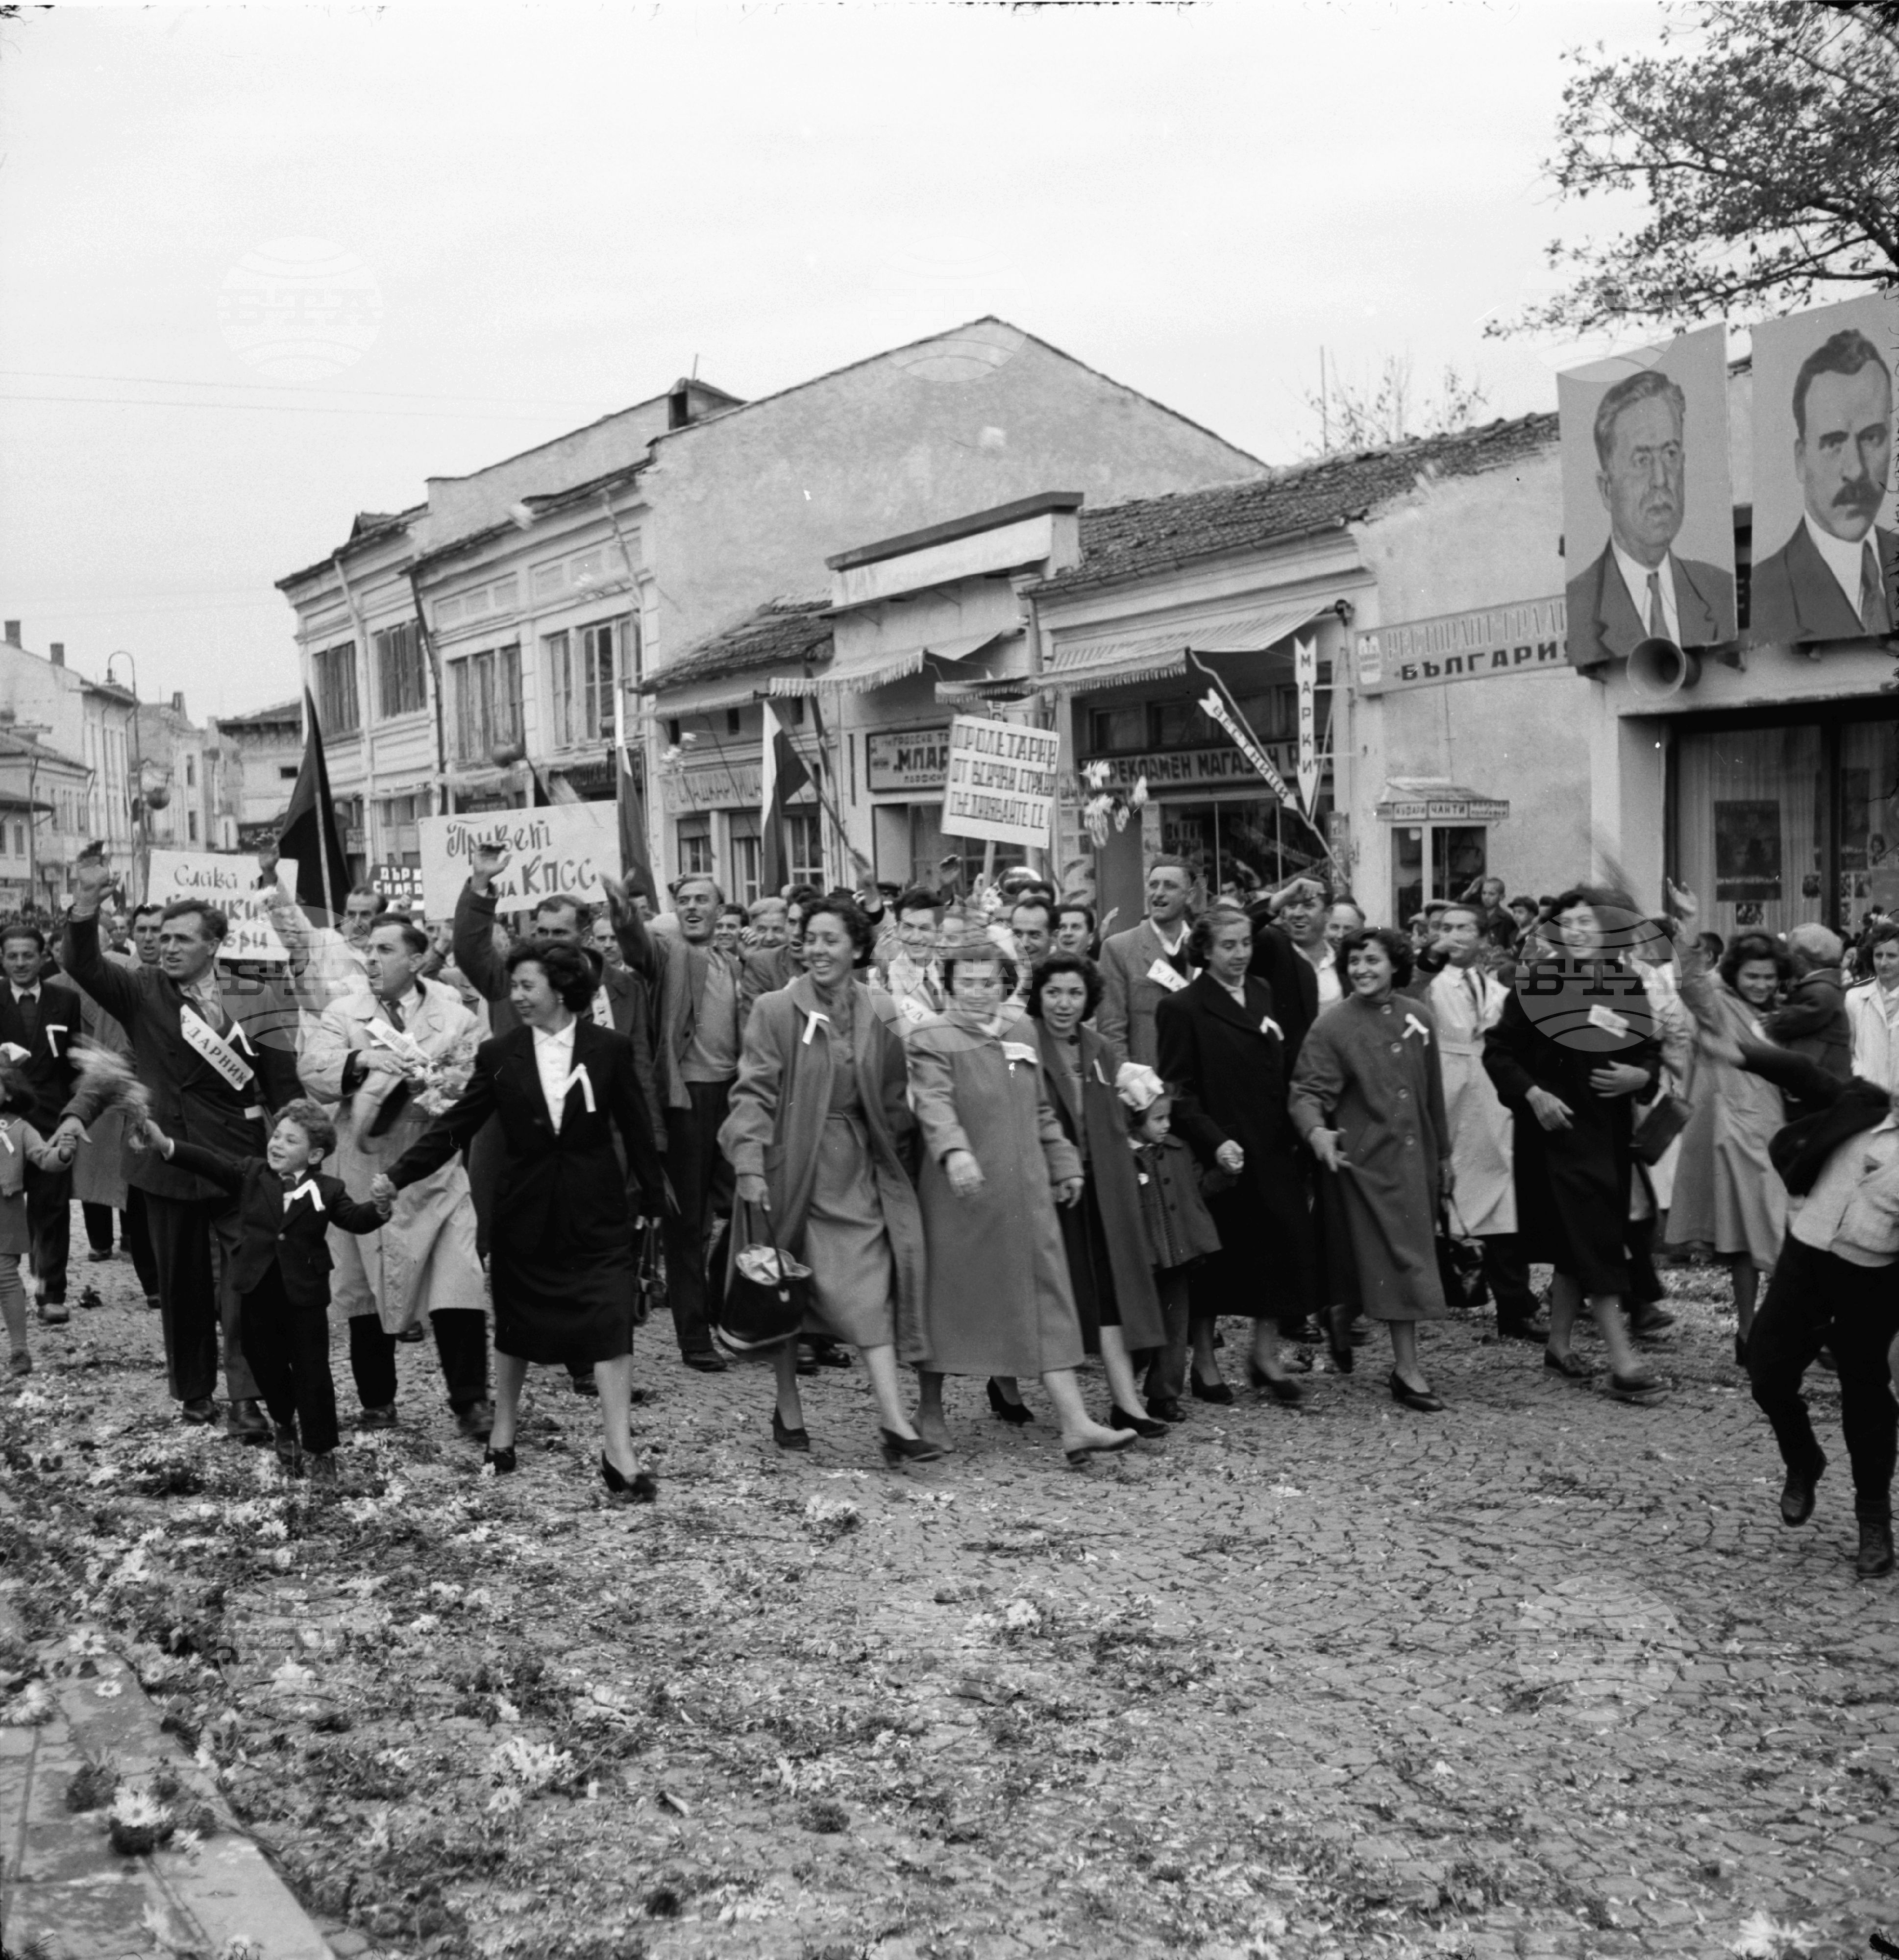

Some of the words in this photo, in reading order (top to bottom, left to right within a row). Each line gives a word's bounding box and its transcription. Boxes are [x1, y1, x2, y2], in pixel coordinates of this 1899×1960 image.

[1400, 640, 1568, 681] БЪЛГАРИ
[1300, 654, 1313, 774] МАРКИ
[1110, 753, 1191, 784] РЕКЛАМЕН
[1197, 748, 1280, 777] МАГАЗН
[1213, 706, 1289, 799] ВЕСТНИЦИ
[1430, 804, 1465, 814] ЧАНТИ
[174, 864, 238, 889] Слава
[521, 854, 597, 896] КПСС
[181, 1014, 247, 1084] УДАРНИК
